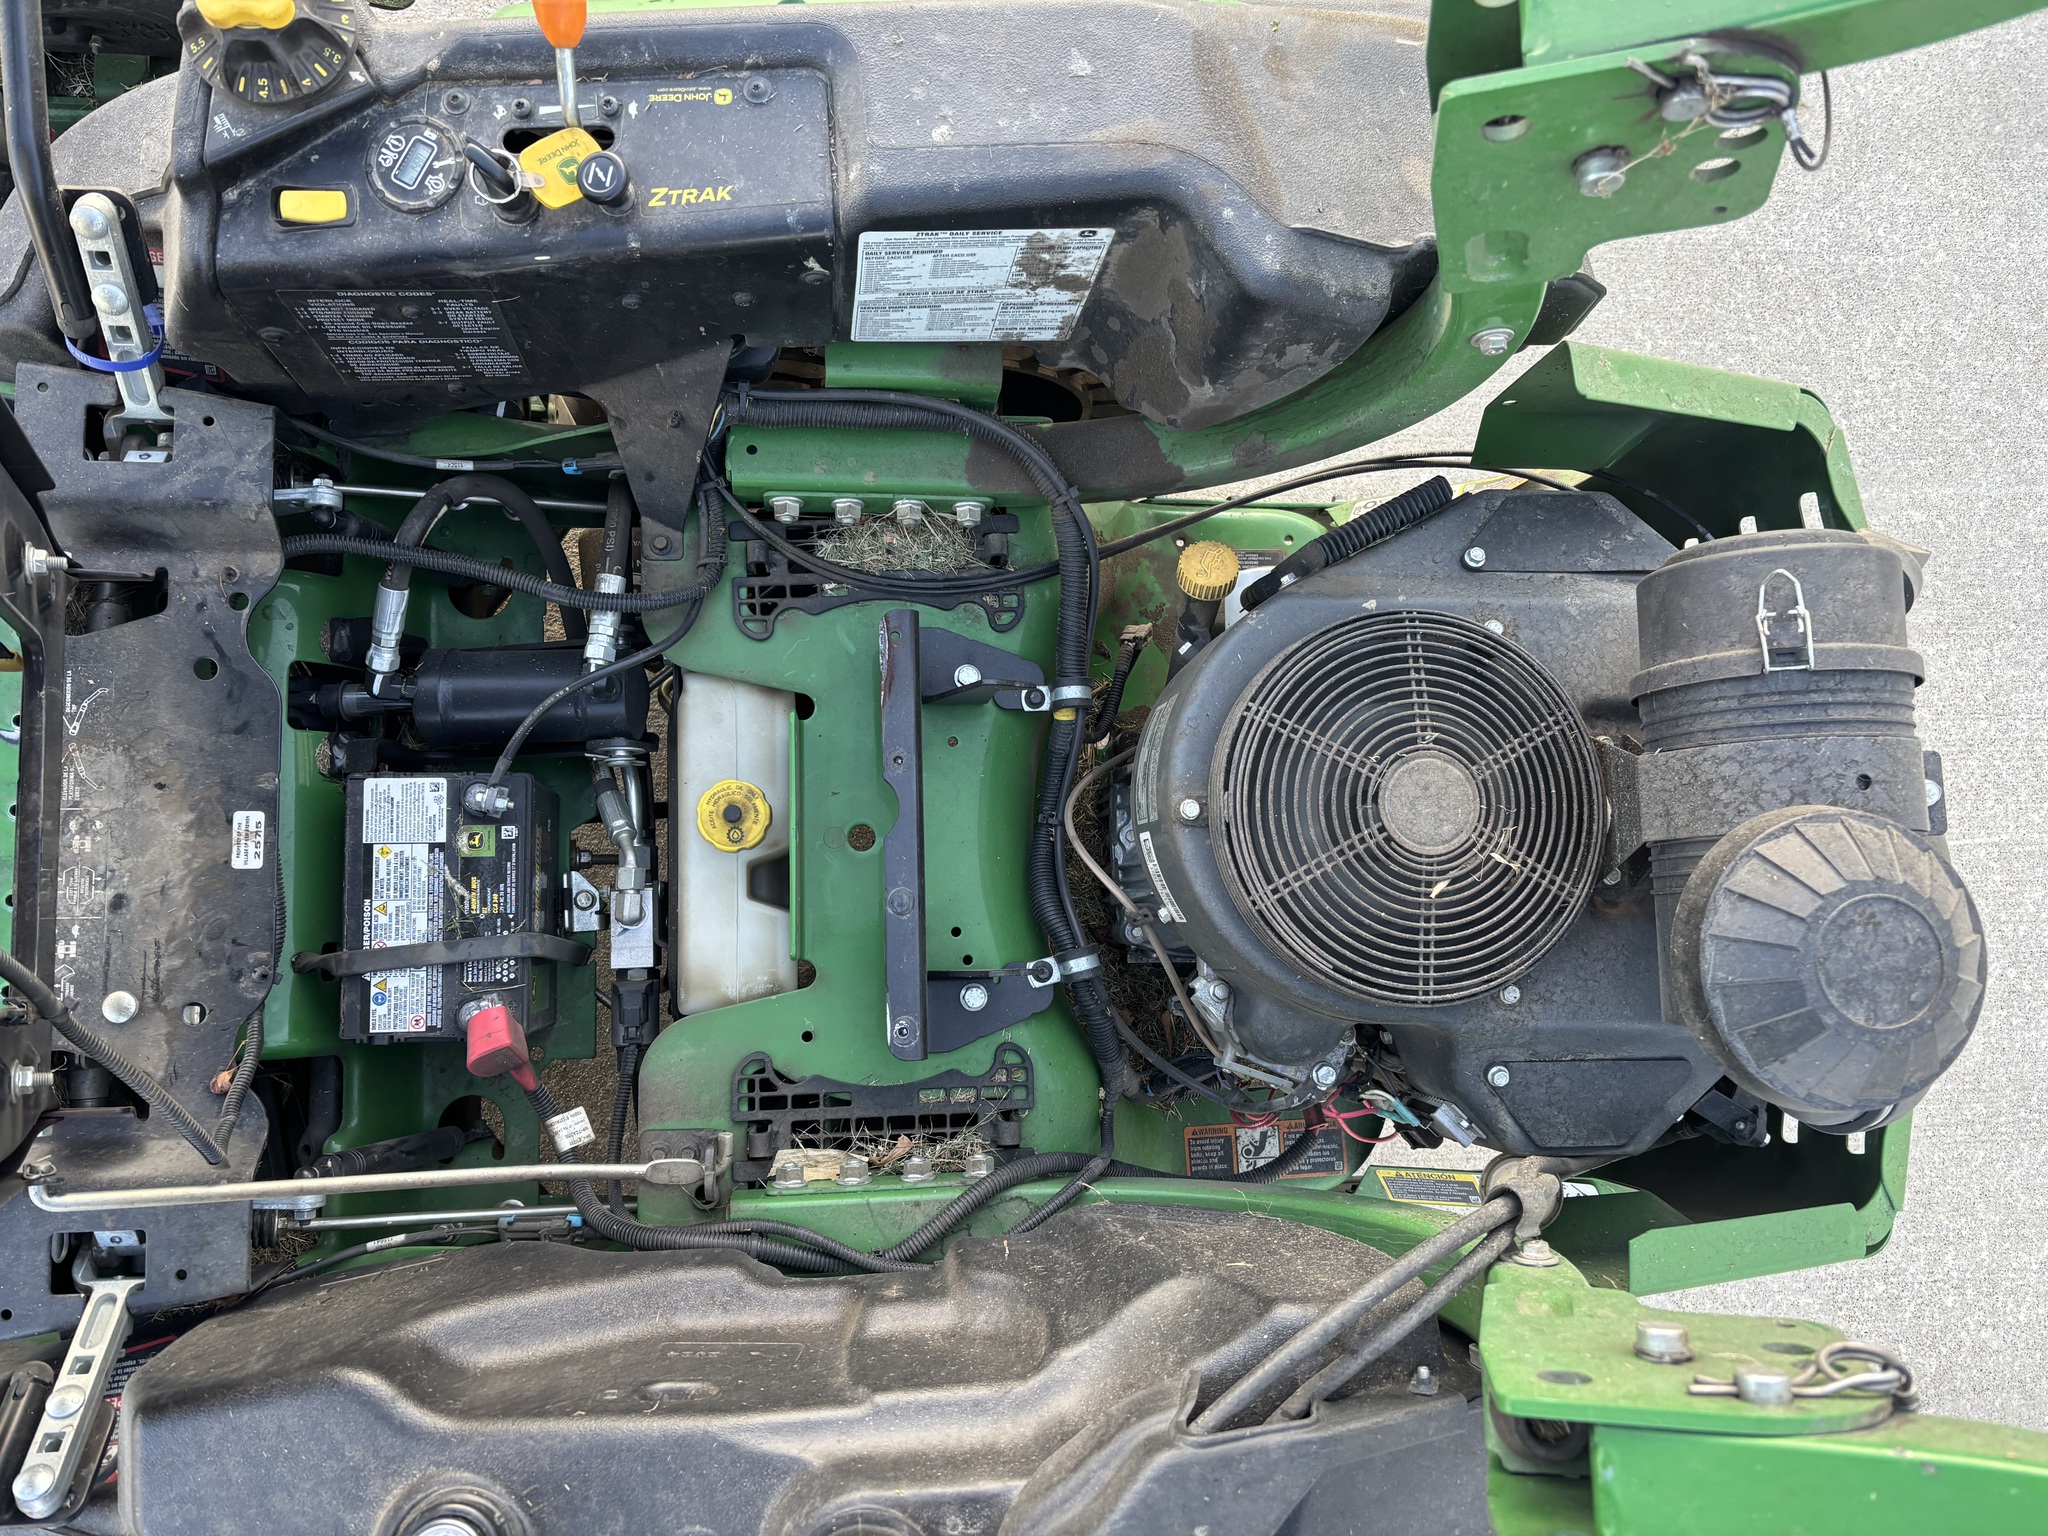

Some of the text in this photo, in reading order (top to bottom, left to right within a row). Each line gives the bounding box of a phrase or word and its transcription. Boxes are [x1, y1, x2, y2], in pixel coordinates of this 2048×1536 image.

[341, 14, 349, 24] 3
[190, 38, 205, 53] 5.5
[324, 47, 341, 63] 3.5
[258, 78, 268, 98] 4.5
[649, 94, 711, 102] JOHN DEERE
[538, 138, 580, 166] JOHN DEERE
[648, 184, 734, 207] ZTRAK
[605, 530, 616, 552] PSI)
[707, 785, 733, 805] HYDRAULIC
[1198, 1127, 1228, 1136] WARNING
[1405, 1172, 1456, 1180] ATENCIÓN
